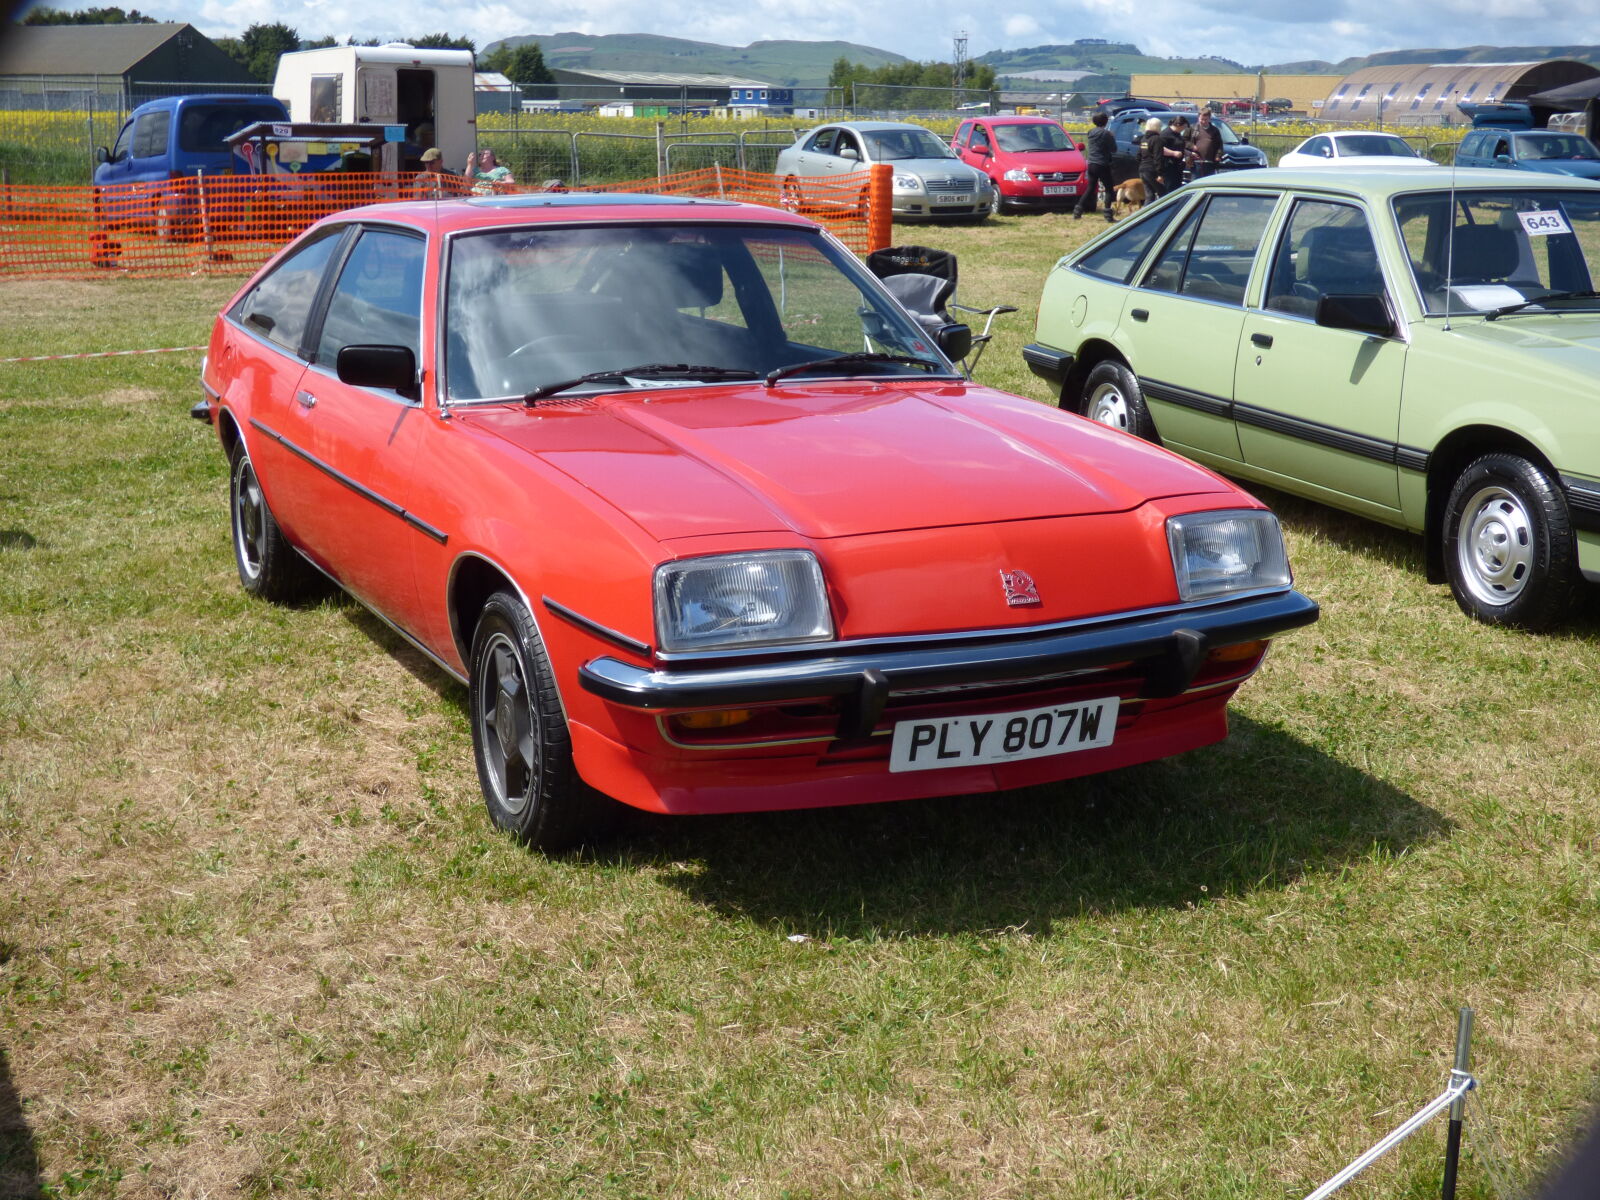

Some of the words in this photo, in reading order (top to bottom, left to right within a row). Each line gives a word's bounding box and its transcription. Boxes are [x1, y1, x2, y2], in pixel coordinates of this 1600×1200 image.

[1526, 216, 1560, 229] 643
[908, 719, 994, 762] PLY
[1003, 705, 1103, 753] 807W
